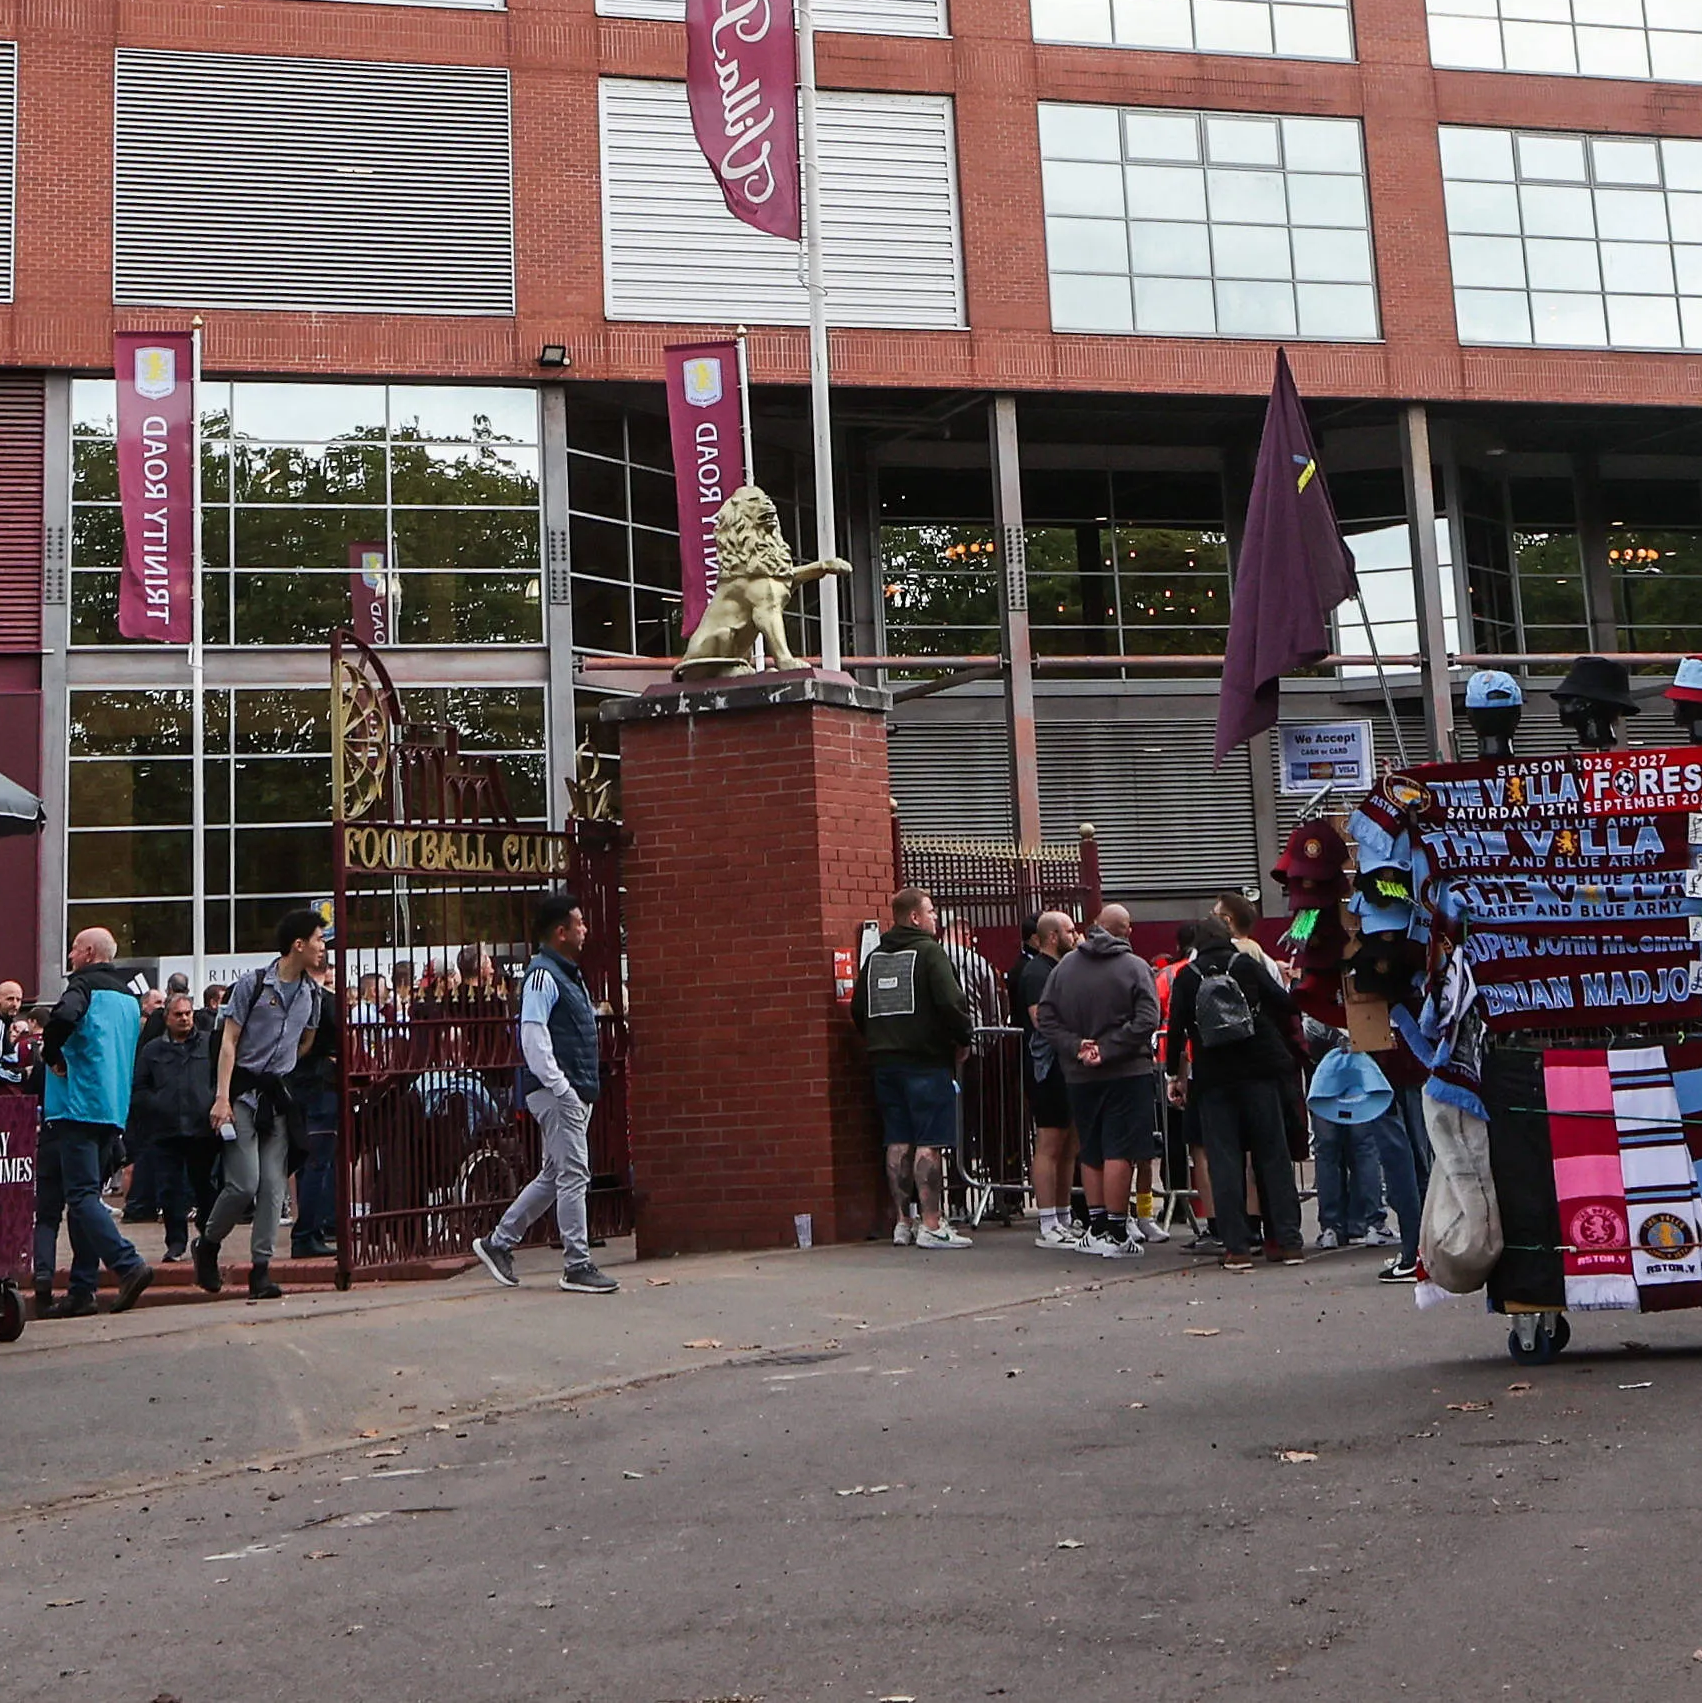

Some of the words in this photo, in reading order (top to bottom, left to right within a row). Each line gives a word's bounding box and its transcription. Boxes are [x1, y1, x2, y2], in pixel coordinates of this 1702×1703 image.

[1294, 734, 1312, 744] We
[1315, 732, 1356, 745] Accept
[1300, 748, 1319, 756] CASH
[1329, 747, 1348, 755] CARD
[1338, 765, 1356, 775] VISA
[1497, 760, 1565, 776] SEASON
[1629, 754, 1667, 767] 2027
[1425, 779, 1482, 807] THE
[1484, 772, 1580, 807] VLLA
[1447, 805, 1530, 820] SATURDAY
[1539, 802, 1578, 817] 12TH
[1583, 794, 1677, 813] SEPTEMBER
[1607, 815, 1658, 827] ARMY
[344, 826, 493, 872] FOOTBALL
[502, 833, 571, 875] CLUB
[1420, 830, 1510, 859] THE
[1523, 825, 1666, 857] VLLA
[1438, 857, 1501, 870] CLARET
[1510, 856, 1546, 868] AND
[1554, 855, 1601, 868] BLUE
[1608, 854, 1659, 867] ARMY
[1576, 874, 1623, 886] BLUE
[1632, 872, 1685, 886] ARMY
[1449, 881, 1535, 906] THE
[1548, 884, 1686, 905] VLLA
[1536, 904, 1572, 917] AND
[1580, 903, 1625, 917] BLUE
[1634, 901, 1683, 915] ARMY
[1466, 932, 1531, 966] SUPER
[1477, 975, 1574, 1016] BRIAN
[1582, 967, 1691, 1007] MADJO
